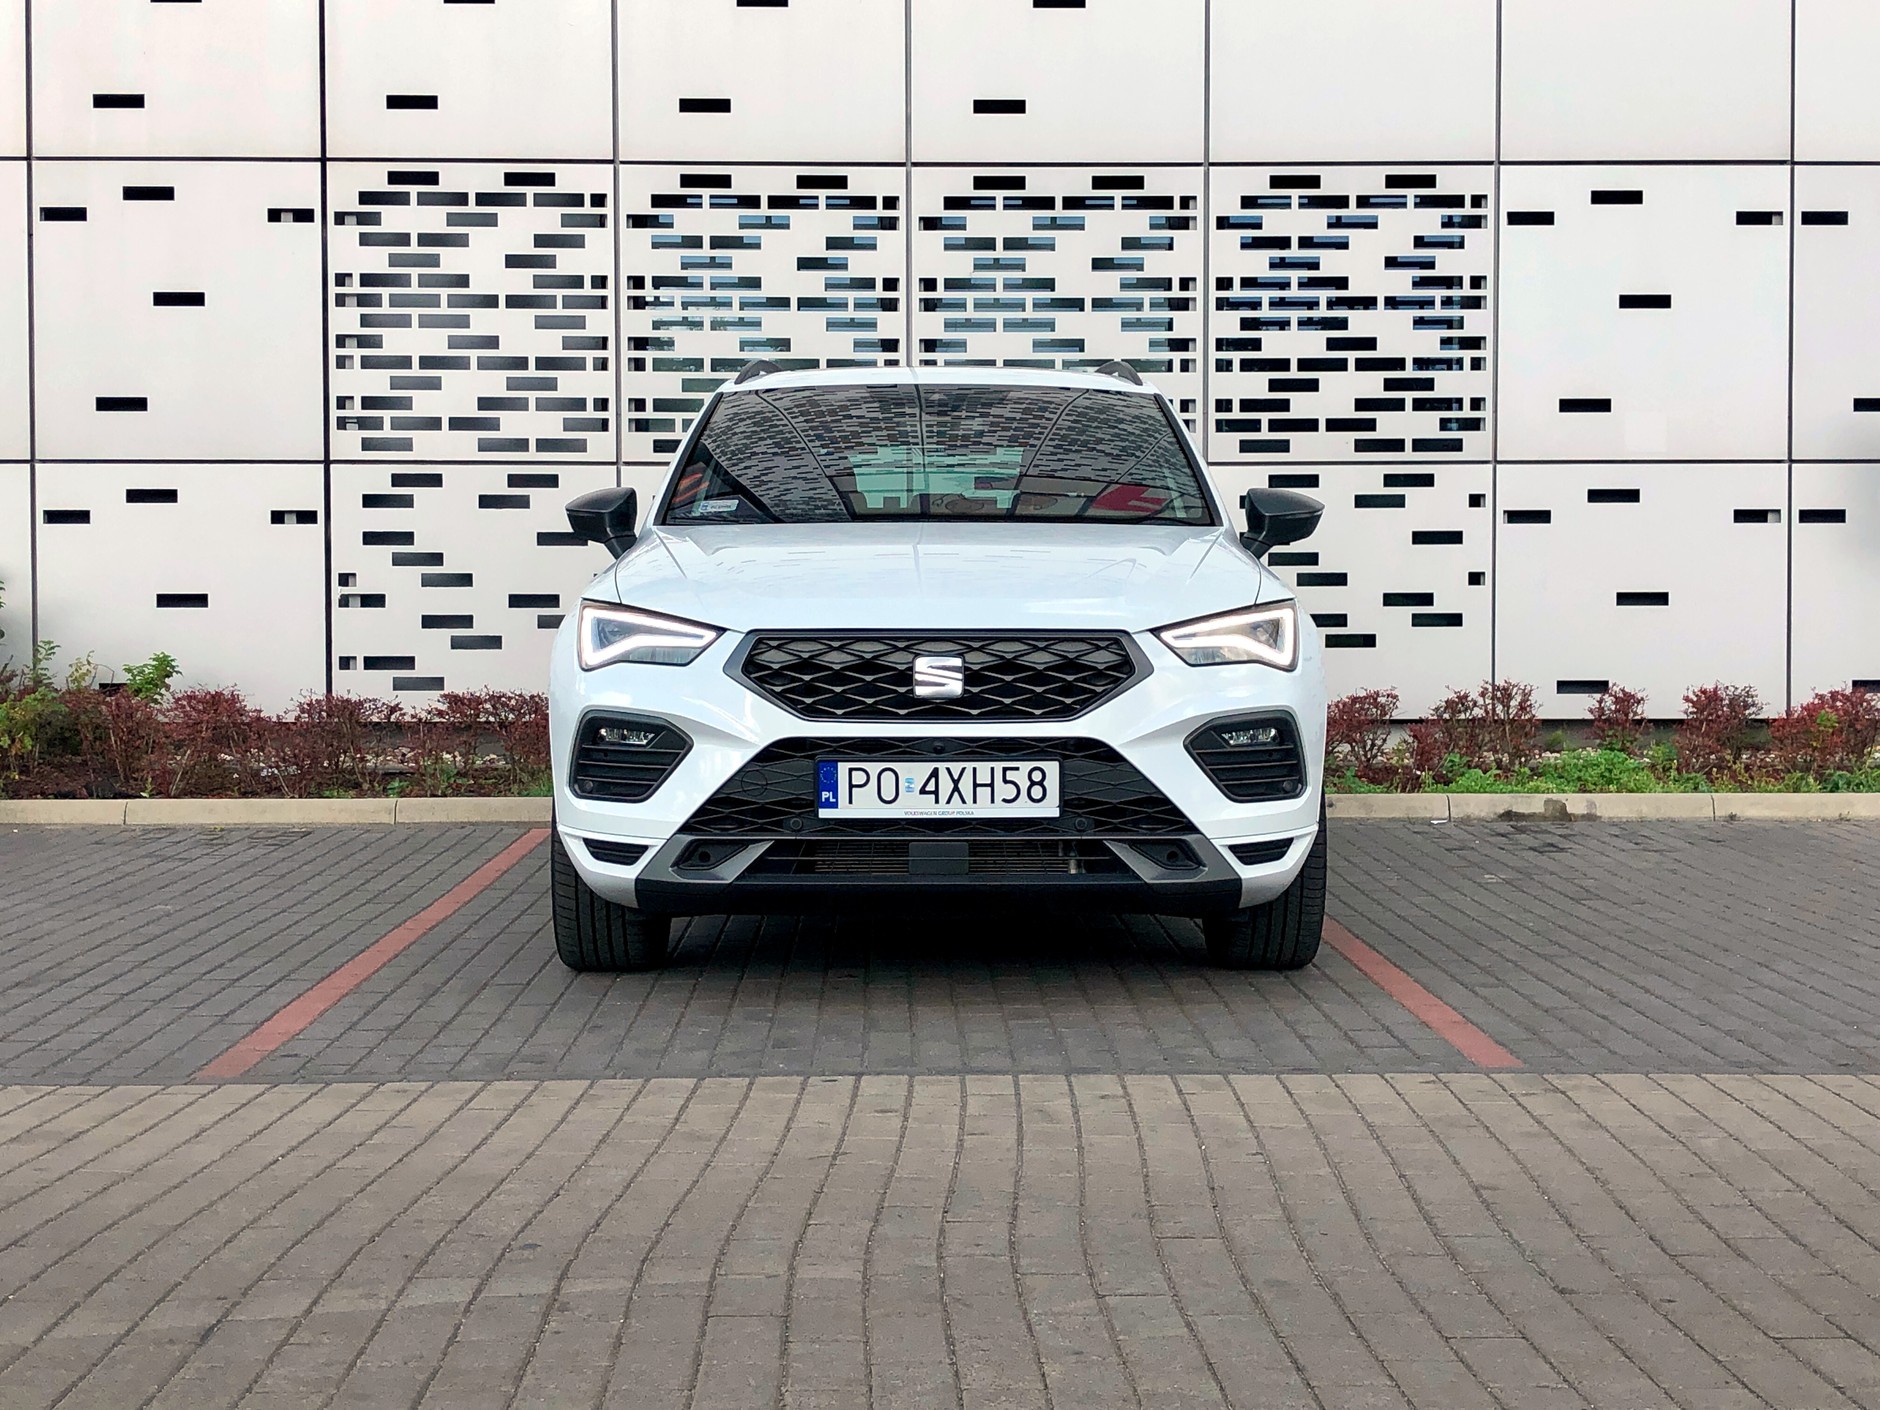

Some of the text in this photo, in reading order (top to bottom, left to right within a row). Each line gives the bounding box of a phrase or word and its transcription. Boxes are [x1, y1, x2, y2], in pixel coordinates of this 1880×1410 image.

[821, 791, 836, 802] PL
[847, 766, 1048, 805] PO 4XH58
